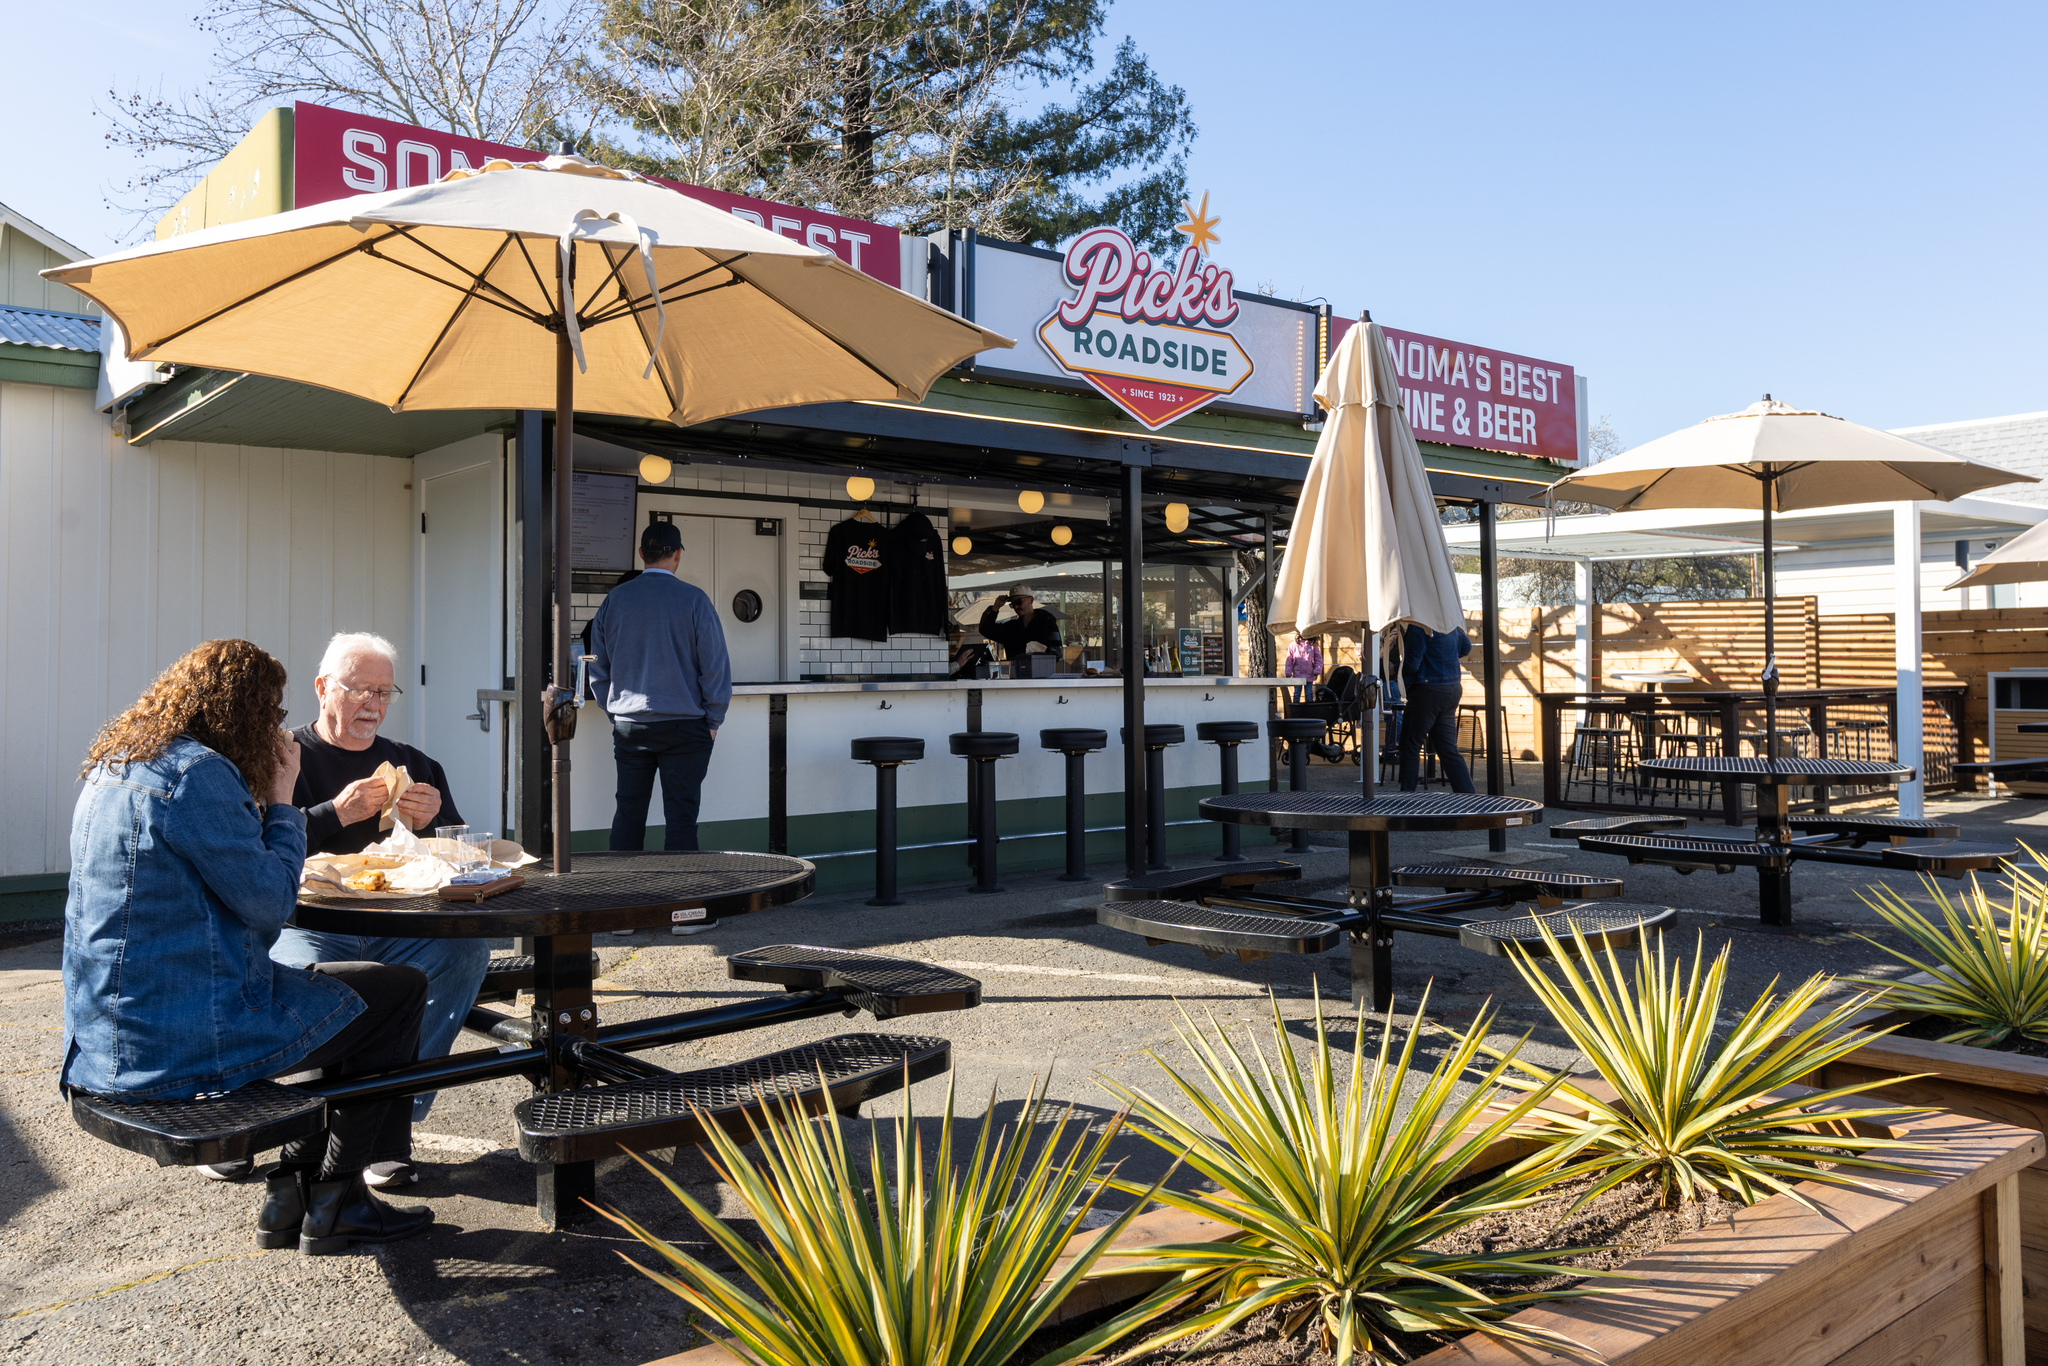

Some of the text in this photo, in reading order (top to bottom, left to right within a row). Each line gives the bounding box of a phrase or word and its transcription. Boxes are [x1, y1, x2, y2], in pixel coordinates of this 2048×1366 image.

[1059, 229, 1239, 331] Pick's
[1074, 326, 1227, 376] ROADSIDE
[1386, 337, 1562, 404] NOMA'S BEST
[1130, 388, 1176, 402] SINCE 1923
[1452, 397, 1471, 436] &
[1478, 401, 1538, 445] BEER
[846, 545, 880, 560] Pick's
[847, 559, 877, 567] ROADSIDE
